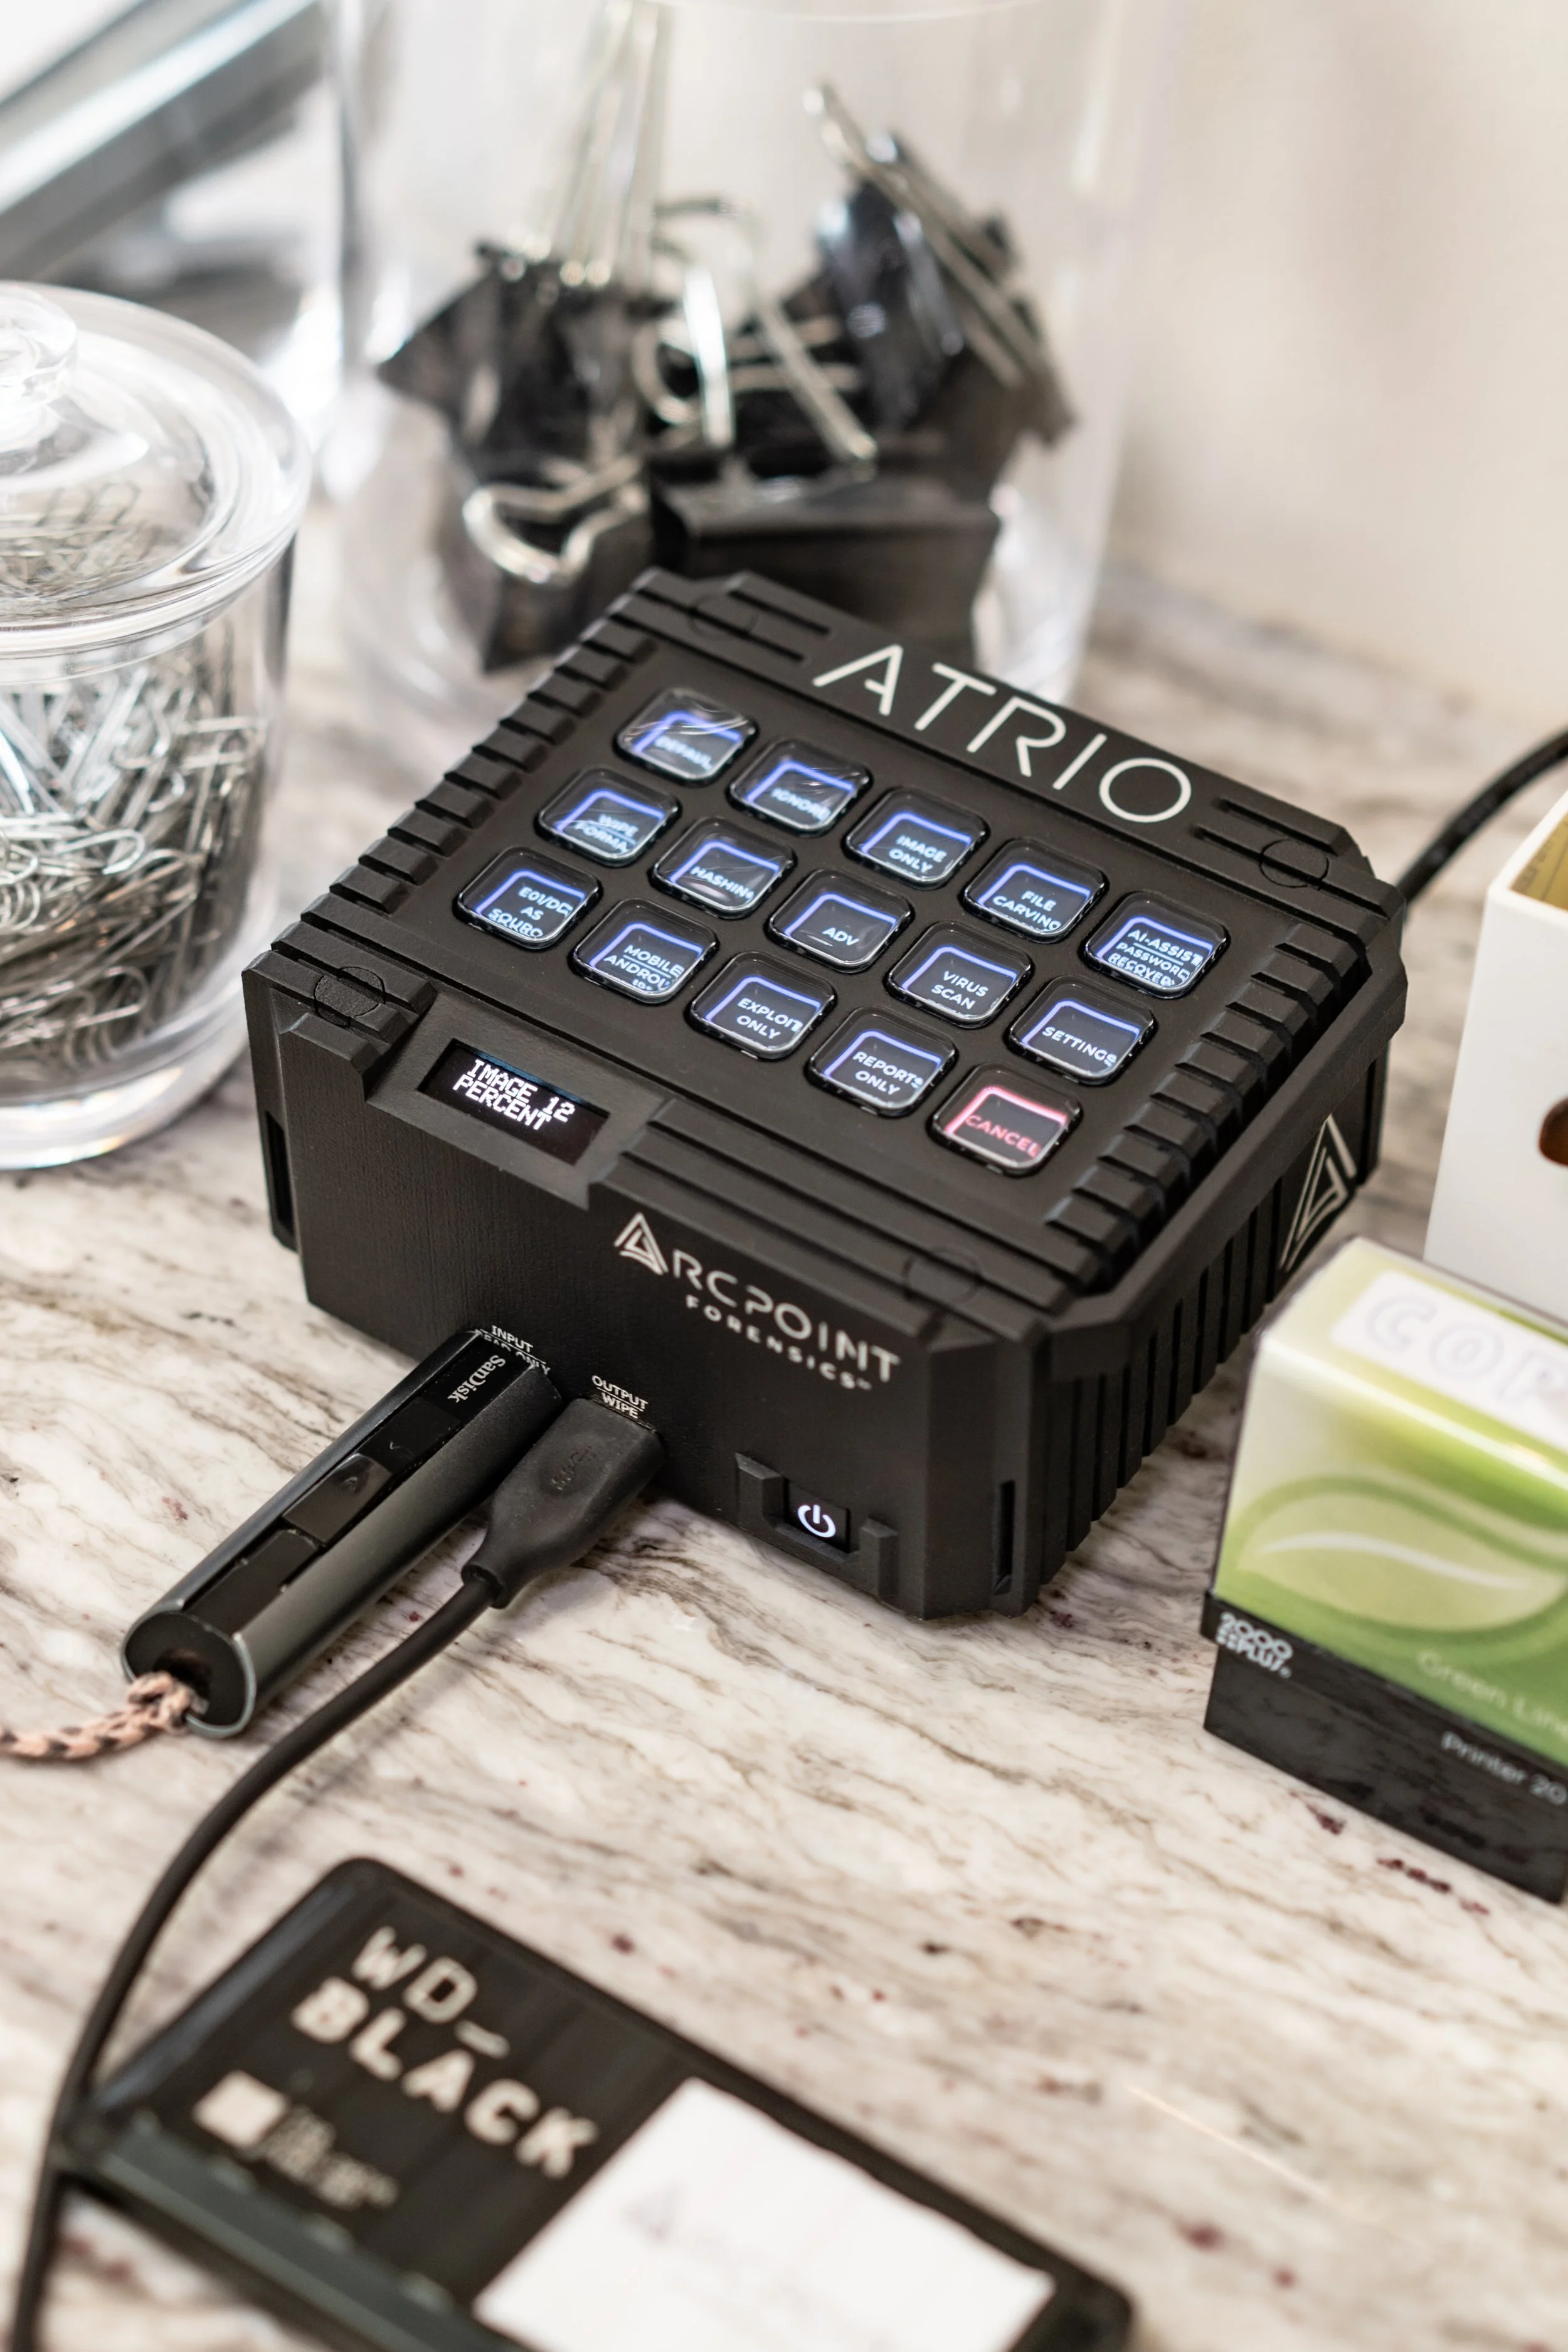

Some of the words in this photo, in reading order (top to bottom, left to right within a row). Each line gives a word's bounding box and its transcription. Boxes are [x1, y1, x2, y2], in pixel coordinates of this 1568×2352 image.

[813, 644, 1191, 823] ATRIO
[573, 822, 628, 854] FORMA
[895, 835, 948, 863] IMAGE
[888, 848, 933, 874] ONLY
[520, 906, 544, 921] AS
[1020, 890, 1057, 912] FILE
[822, 926, 860, 946] ADV
[623, 945, 685, 978] MOBILE
[1116, 941, 1190, 983] PASSWORD
[931, 984, 976, 1010] SCAN
[943, 971, 989, 997] VIRUS
[736, 1015, 781, 1039] ONLY
[1042, 1026, 1118, 1067] SETTINGS
[852, 1051, 924, 1089] REPORTS
[855, 1070, 901, 1095] ONLY
[452, 1074, 552, 1131] PERCENT
[467, 1059, 539, 1104] IMAGE
[543, 1096, 576, 1123] 12
[966, 1115, 1042, 1158] CANCEL
[491, 1325, 534, 1353] INPUT
[686, 1294, 856, 1390] FORENSICS
[447, 1355, 506, 1403] SanDisk
[591, 1375, 649, 1409] OUTPUT
[601, 1392, 638, 1419] WIPE
[1220, 1612, 1293, 1661] 2000
[1416, 1650, 1508, 1710] Green
[1442, 1730, 1525, 1785] Printer
[290, 1976, 598, 2179] BLACK
